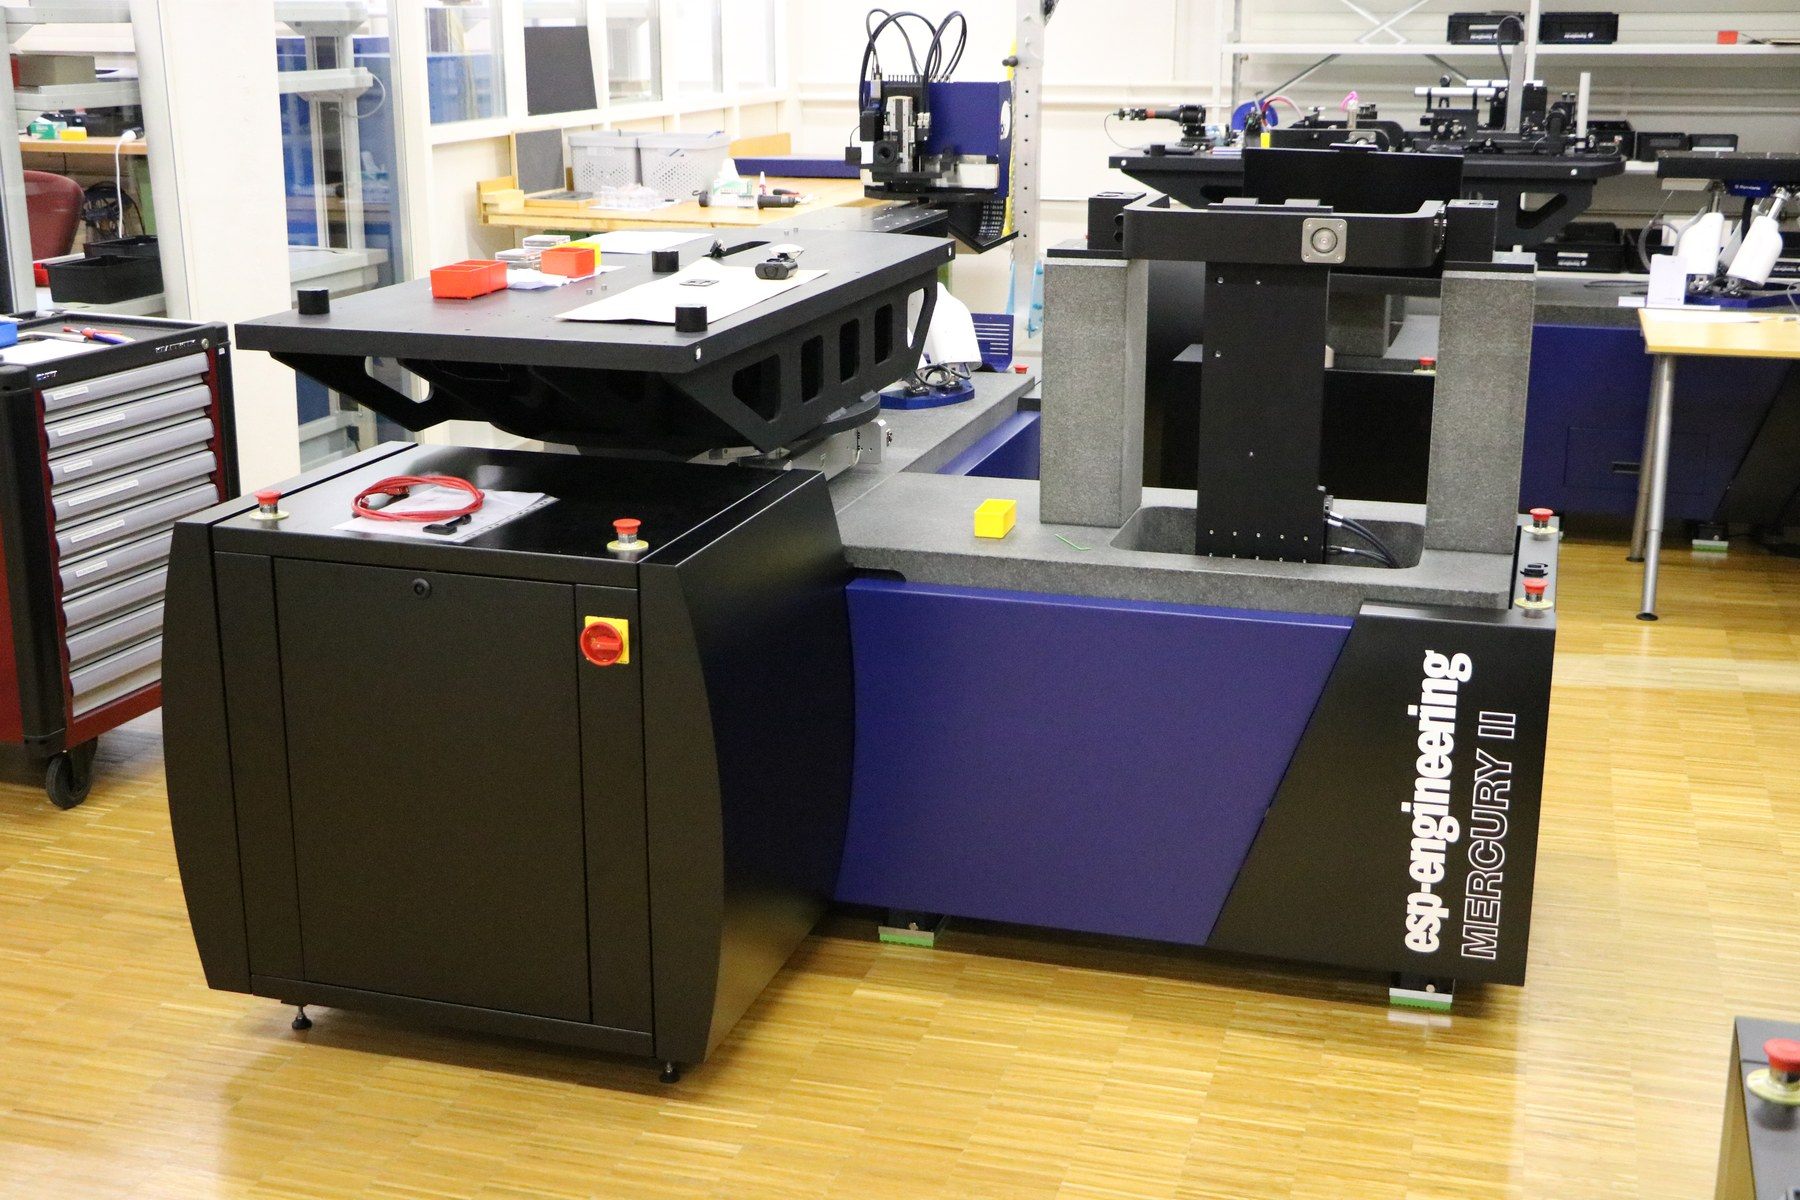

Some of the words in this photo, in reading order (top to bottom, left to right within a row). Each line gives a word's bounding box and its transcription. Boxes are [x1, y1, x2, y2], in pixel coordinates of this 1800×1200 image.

[1401, 650, 1472, 952] esp-engineering
[1478, 710, 1516, 739] II
[1461, 748, 1512, 960] MERCURY
